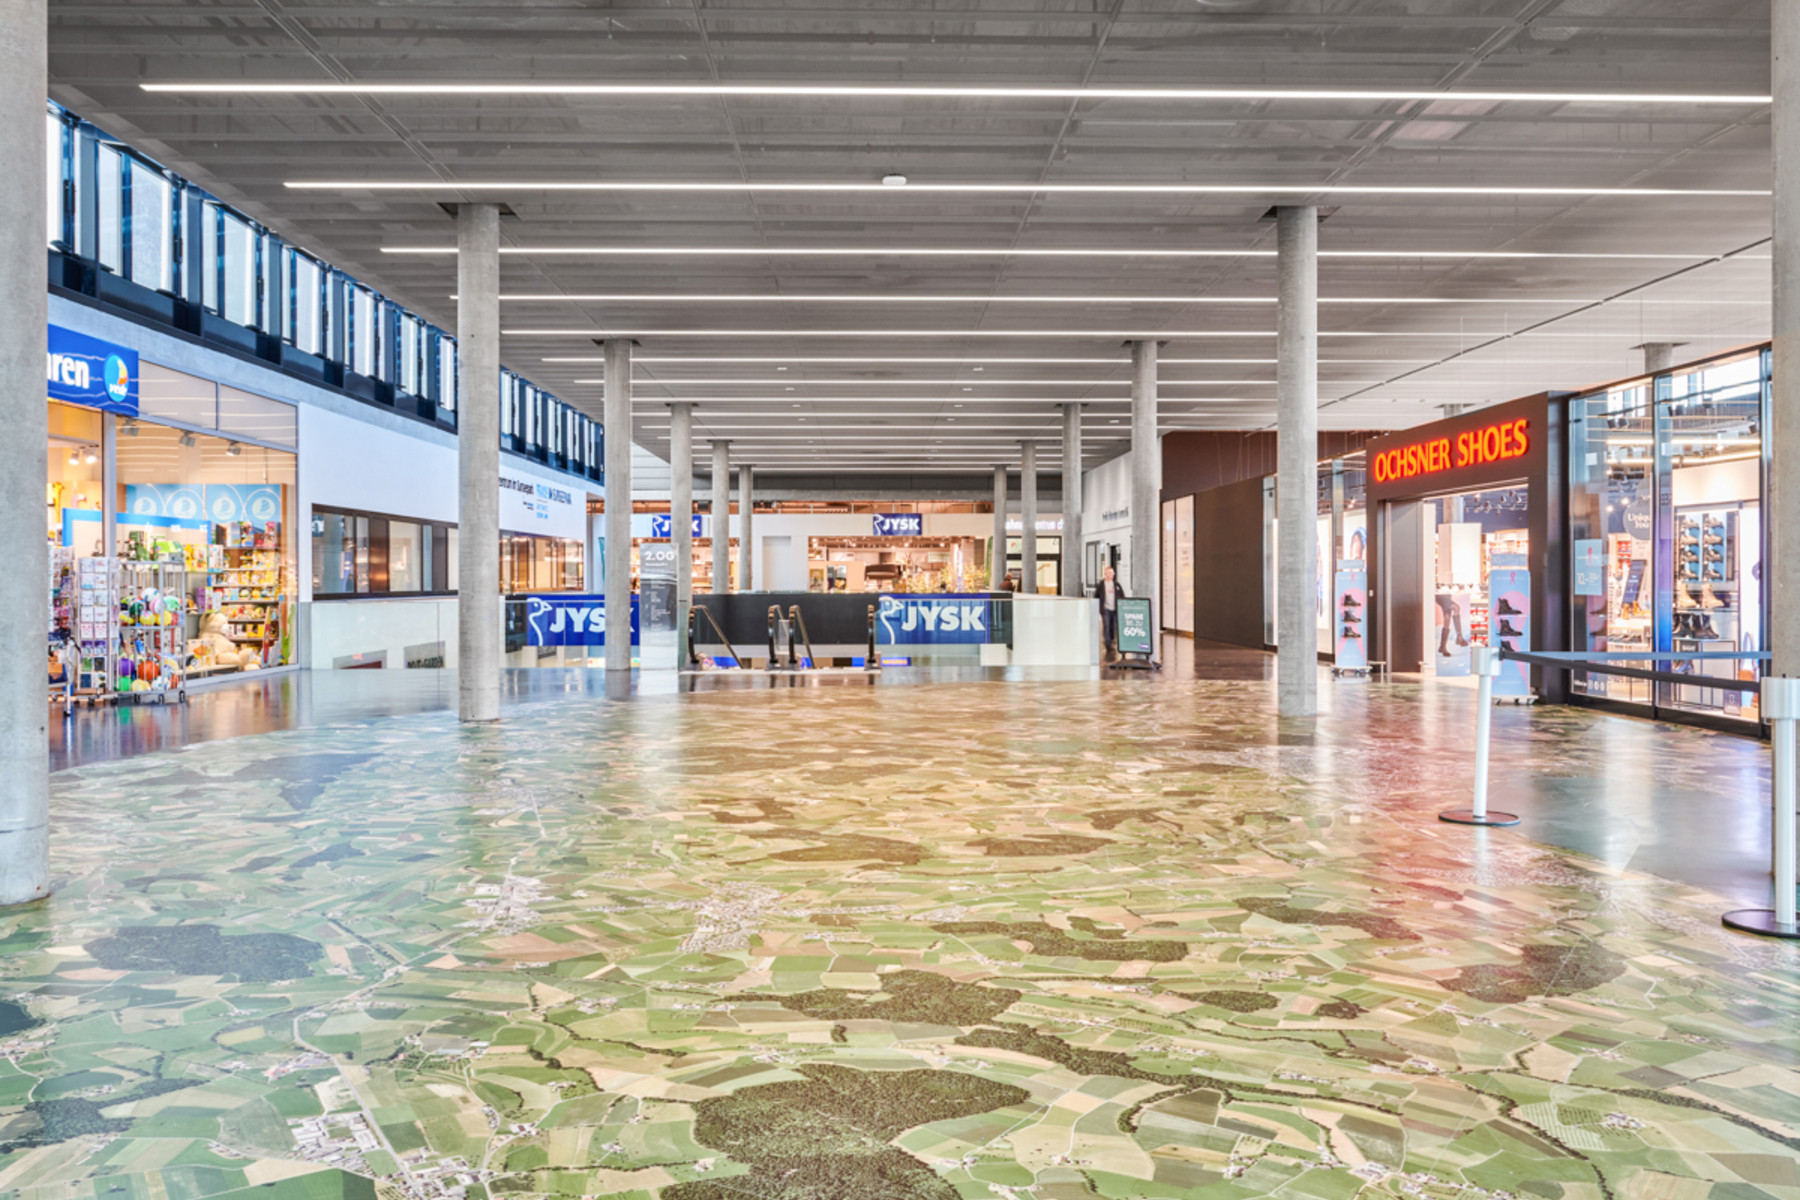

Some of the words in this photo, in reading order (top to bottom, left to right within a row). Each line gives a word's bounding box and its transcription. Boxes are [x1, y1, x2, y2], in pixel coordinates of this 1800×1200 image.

[1375, 438, 1450, 482] OCHSNER
[1457, 419, 1528, 467] SHOES
[662, 520, 700, 531] JK
[883, 518, 920, 530] JYSK
[645, 551, 675, 561] 2.OG
[549, 607, 635, 632] JYS
[901, 606, 986, 631] JYSK
[1123, 627, 1146, 637] 60%
